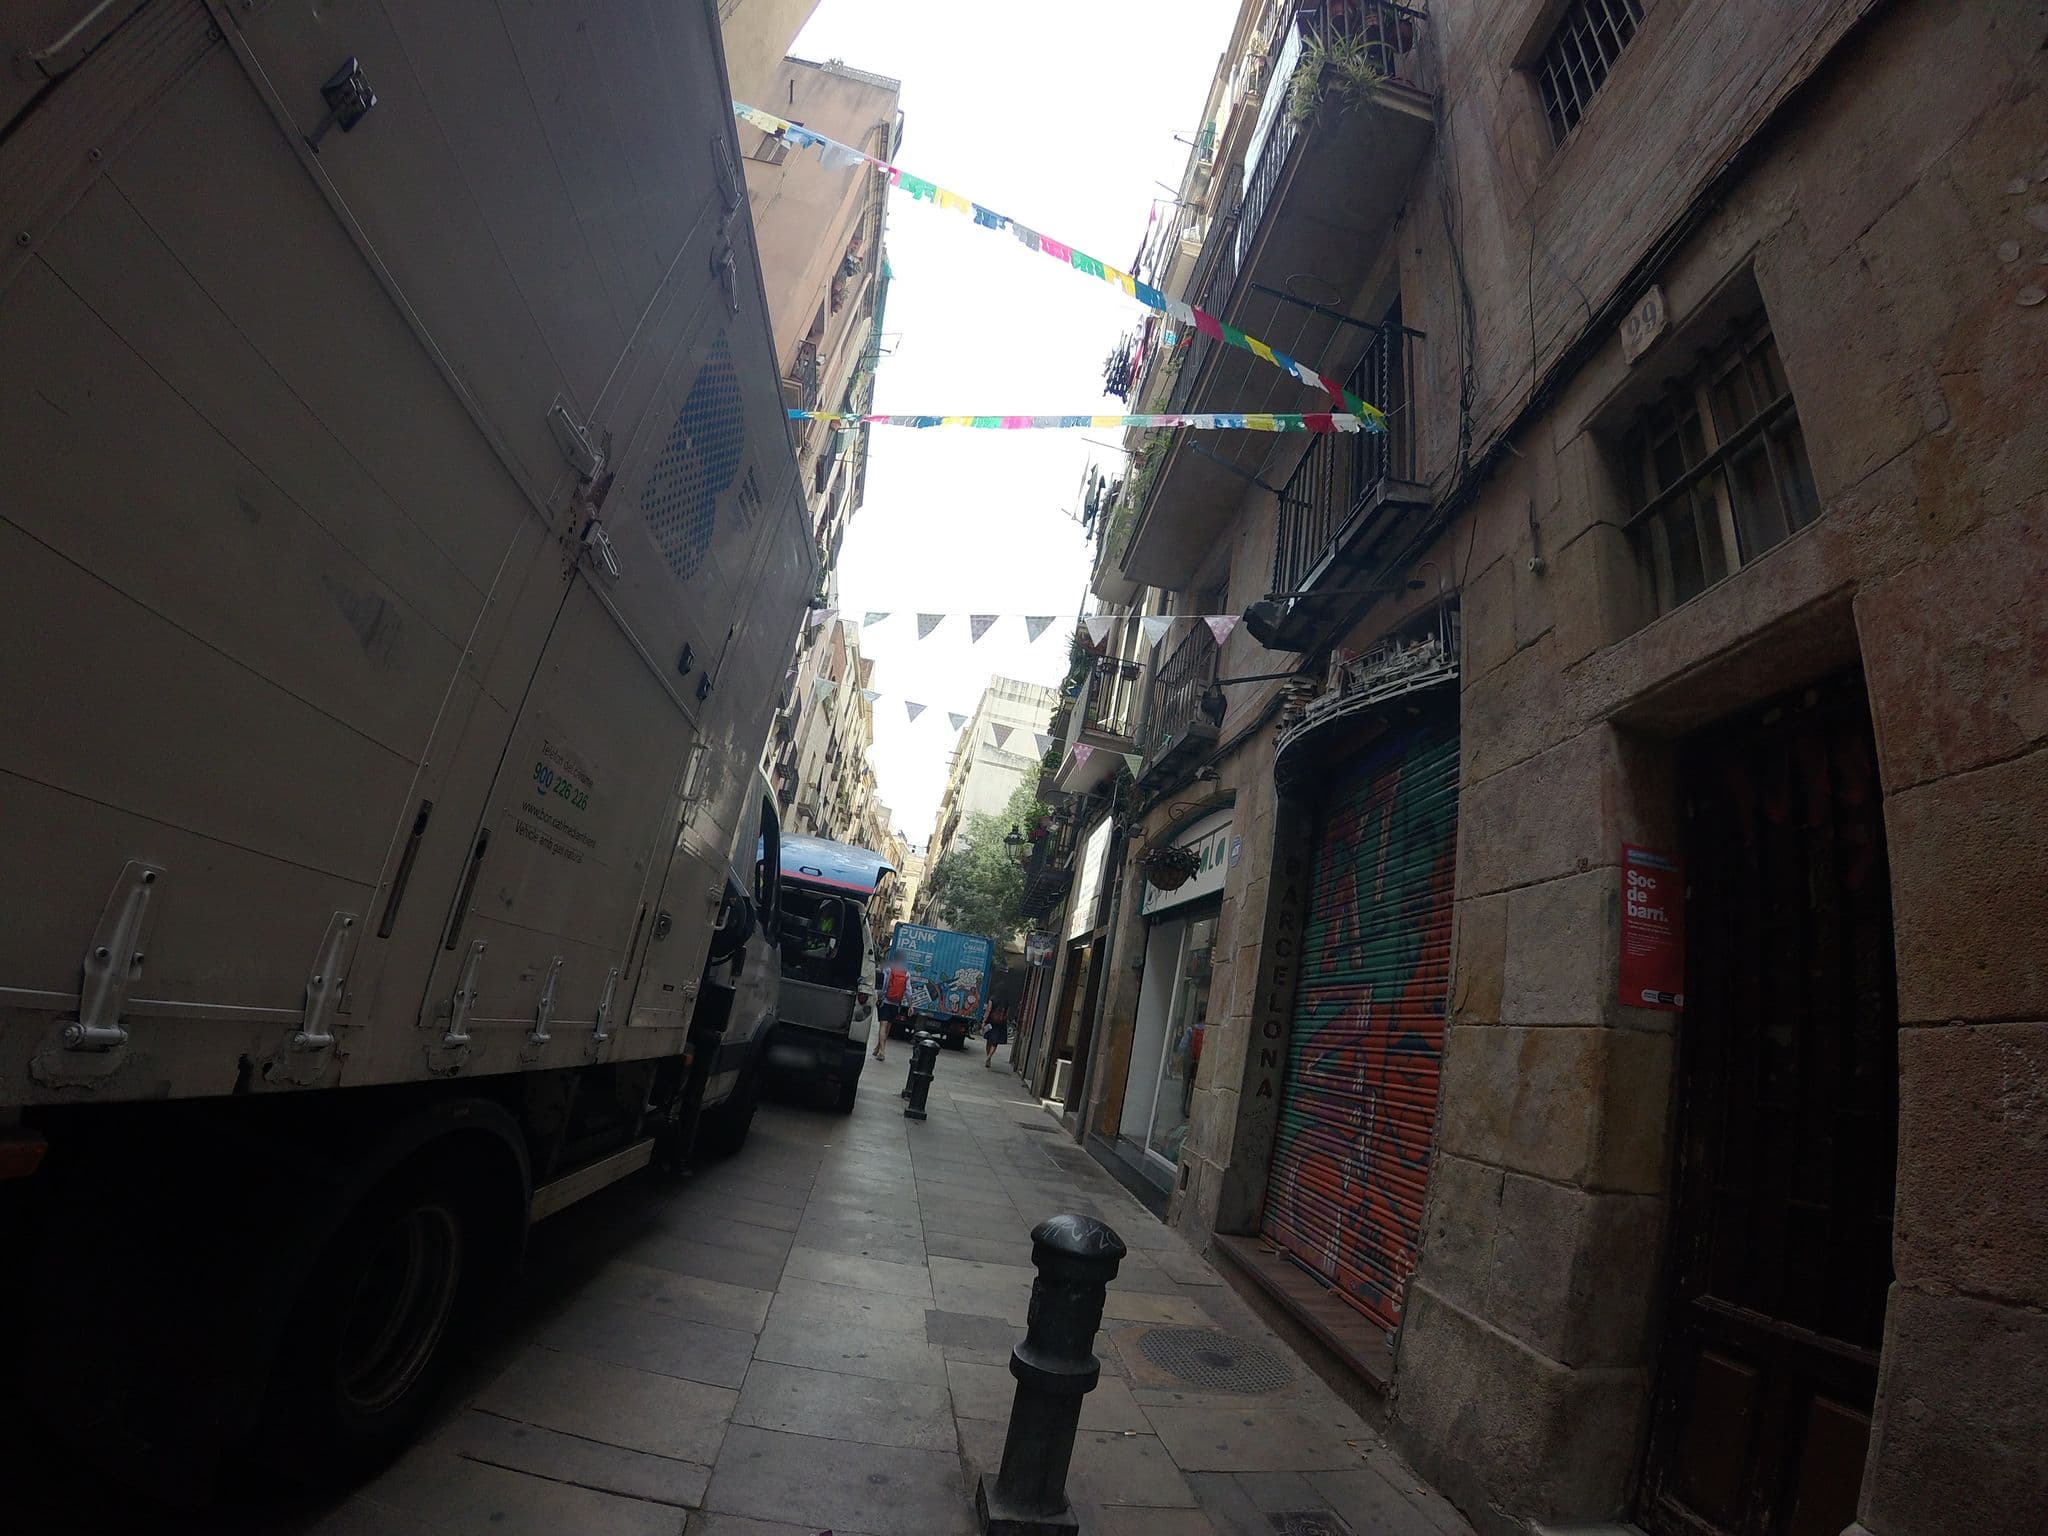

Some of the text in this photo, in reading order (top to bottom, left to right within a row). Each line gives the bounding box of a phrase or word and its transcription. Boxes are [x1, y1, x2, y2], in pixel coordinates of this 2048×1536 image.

[1629, 302, 1657, 344] 29
[533, 762, 590, 811] 900 226 226
[1627, 869, 1657, 889] Soc
[1627, 886, 1648, 903] de
[1627, 901, 1669, 923] barri.
[897, 938, 917, 949] IPA
[899, 927, 936, 943] PUNK
[1256, 858, 1300, 1098] BARCELONA
